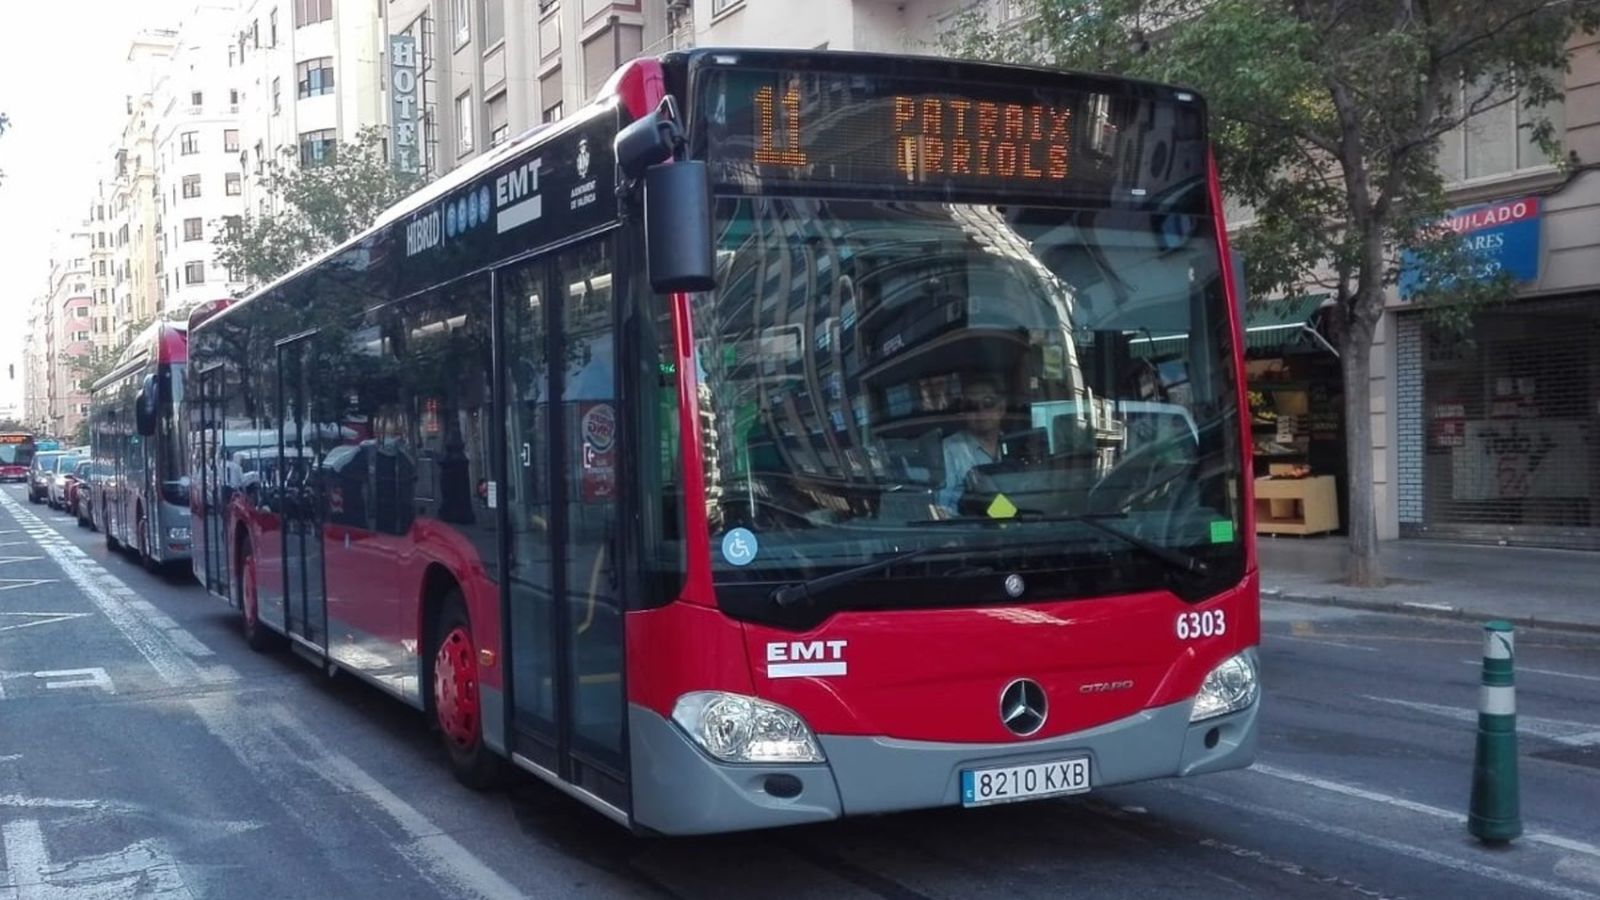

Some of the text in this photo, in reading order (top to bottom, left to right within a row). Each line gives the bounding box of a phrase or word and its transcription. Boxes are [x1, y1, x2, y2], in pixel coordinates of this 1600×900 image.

[392, 42, 416, 174] HOTEL
[754, 86, 806, 165] 11
[896, 96, 1070, 142] PATRAIX
[898, 136, 1068, 179] ORRIOLS
[496, 157, 542, 207] EMT
[1176, 609, 1226, 640] 6303
[767, 640, 848, 661] EMT
[1079, 680, 1134, 694] CITARO
[979, 768, 1037, 798] 8210
[1044, 762, 1085, 792] KXB
